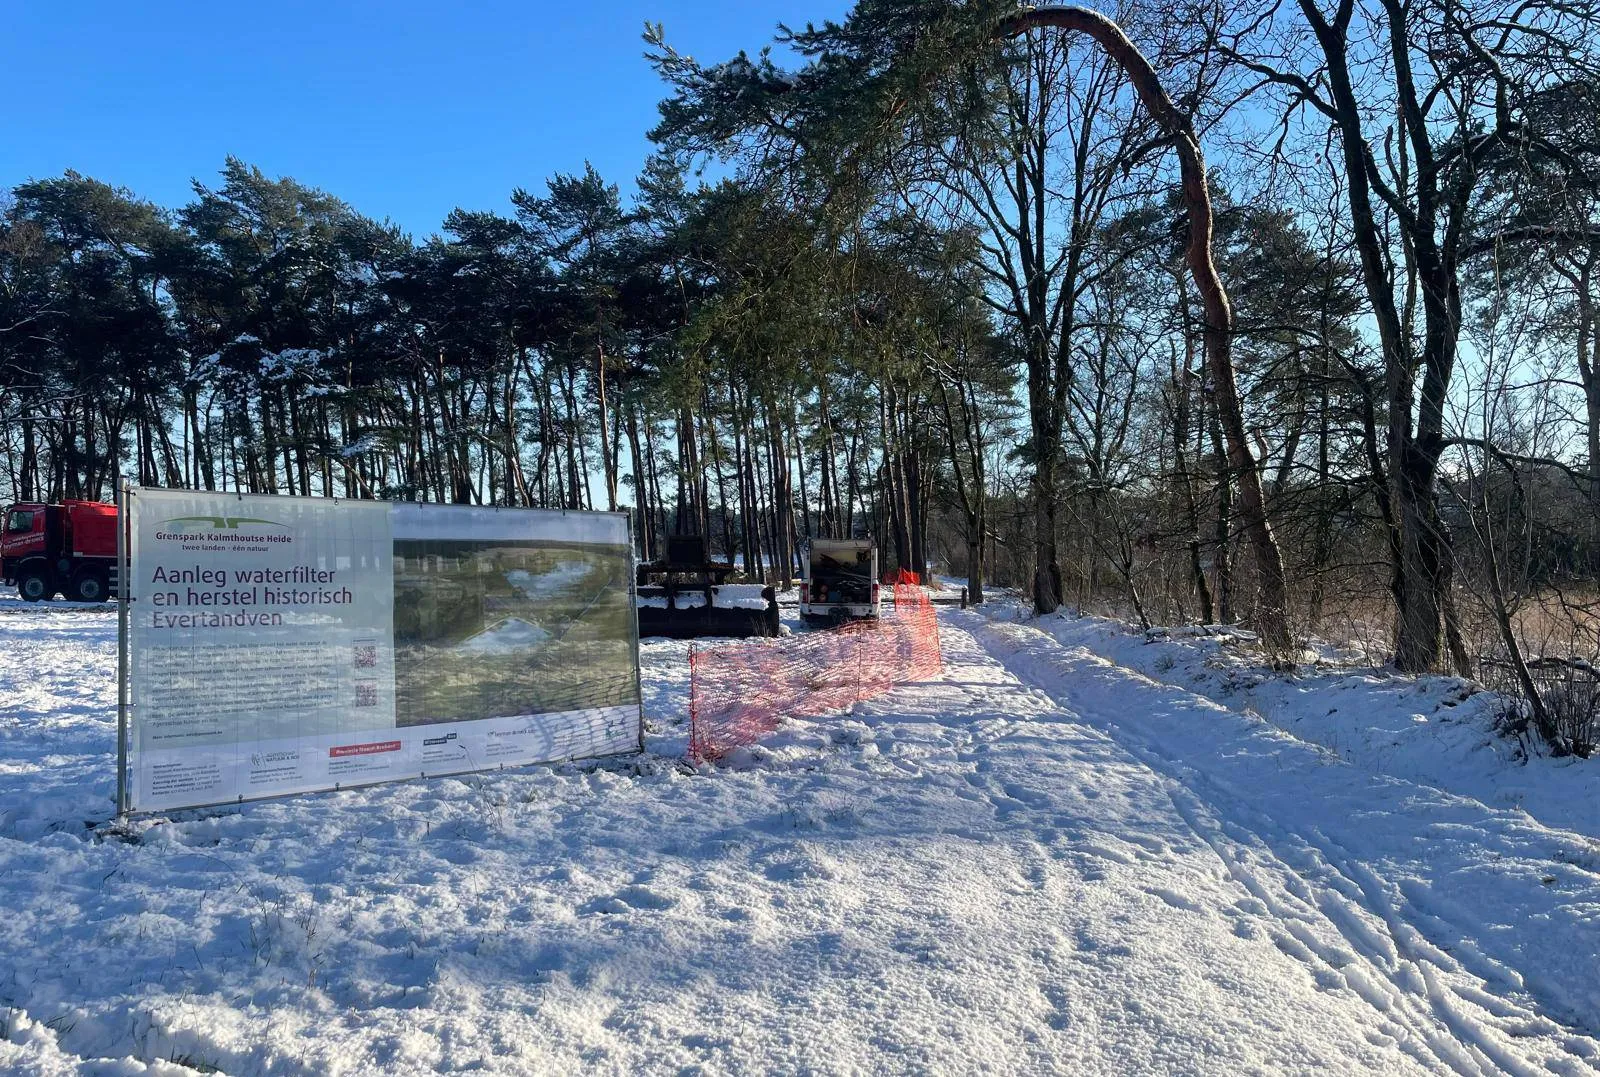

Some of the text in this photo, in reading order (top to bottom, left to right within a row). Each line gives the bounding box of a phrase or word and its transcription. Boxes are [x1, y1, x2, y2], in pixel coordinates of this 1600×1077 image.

[156, 531, 292, 543] Grenspark Kalmthoutse Heide
[152, 565, 336, 588] Aanleg waterfilter
[152, 586, 352, 606] en herstel historisch
[153, 609, 282, 629] Evertandven
